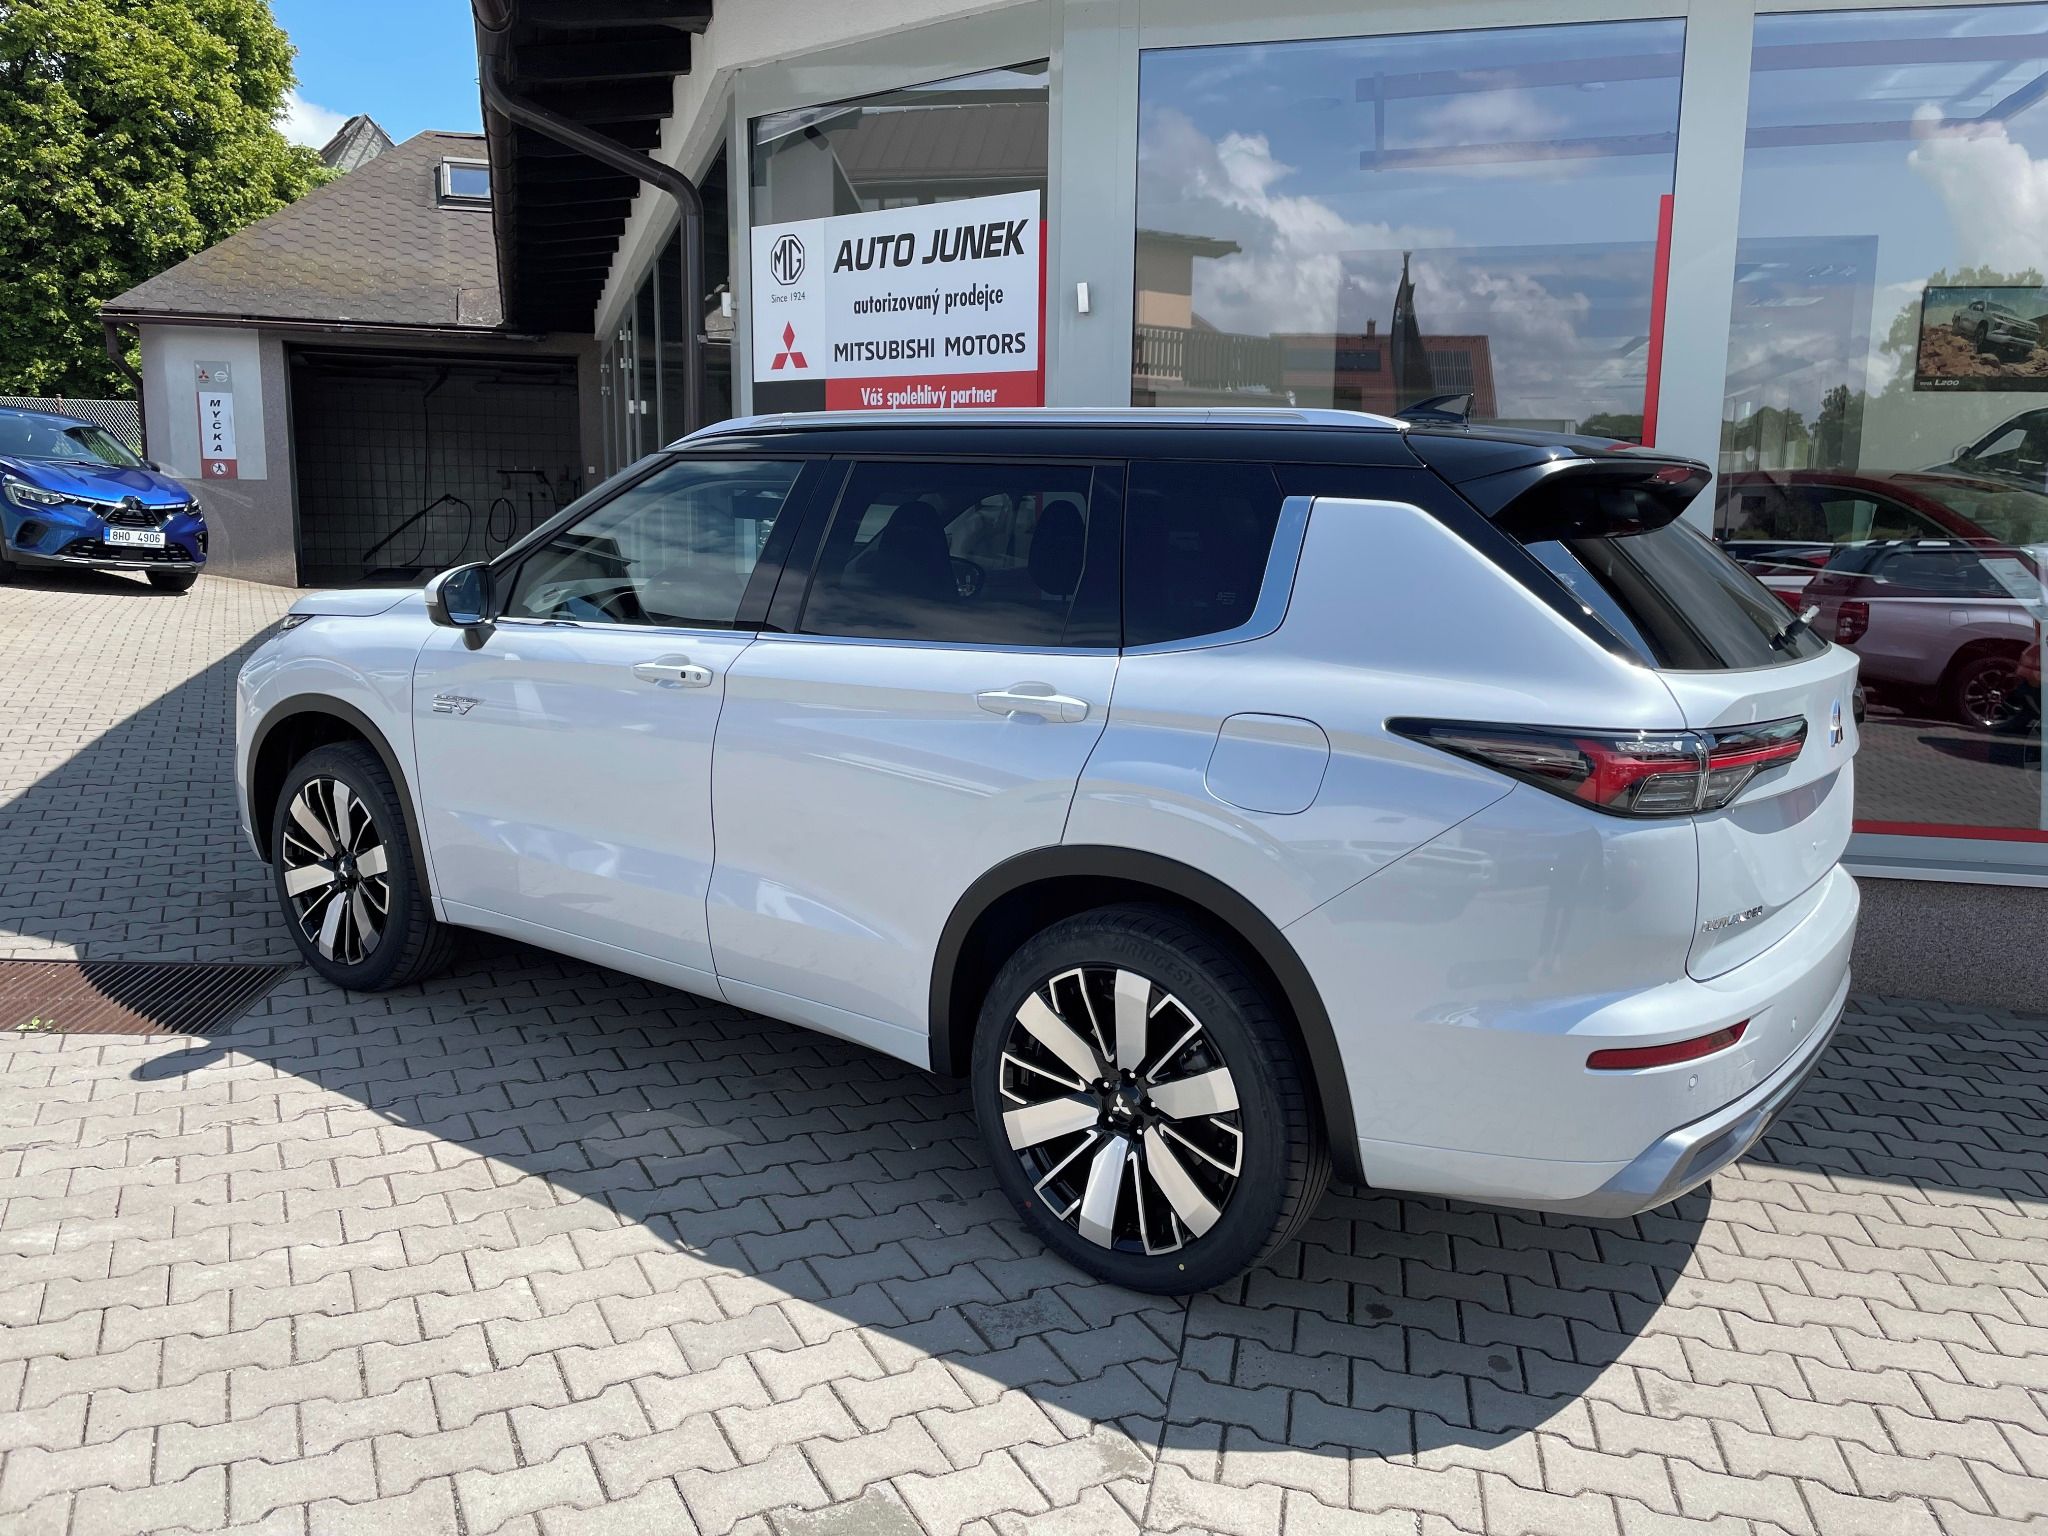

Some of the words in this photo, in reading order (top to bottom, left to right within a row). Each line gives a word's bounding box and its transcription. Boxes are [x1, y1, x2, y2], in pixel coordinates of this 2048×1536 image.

[773, 238, 802, 281] MG
[833, 232, 915, 273] AUTO
[922, 218, 1029, 265] JUNEK
[771, 293, 788, 304] Since
[790, 291, 806, 302] 1924
[853, 288, 941, 315] autorizovaný
[945, 283, 1004, 314] prodejce
[834, 337, 935, 362] MITSUBISHI
[944, 332, 1026, 357] MOTORS
[861, 387, 883, 406] Váš
[886, 385, 947, 409] spolehlivý
[950, 389, 998, 408] partner
[137, 532, 161, 543] 4906
